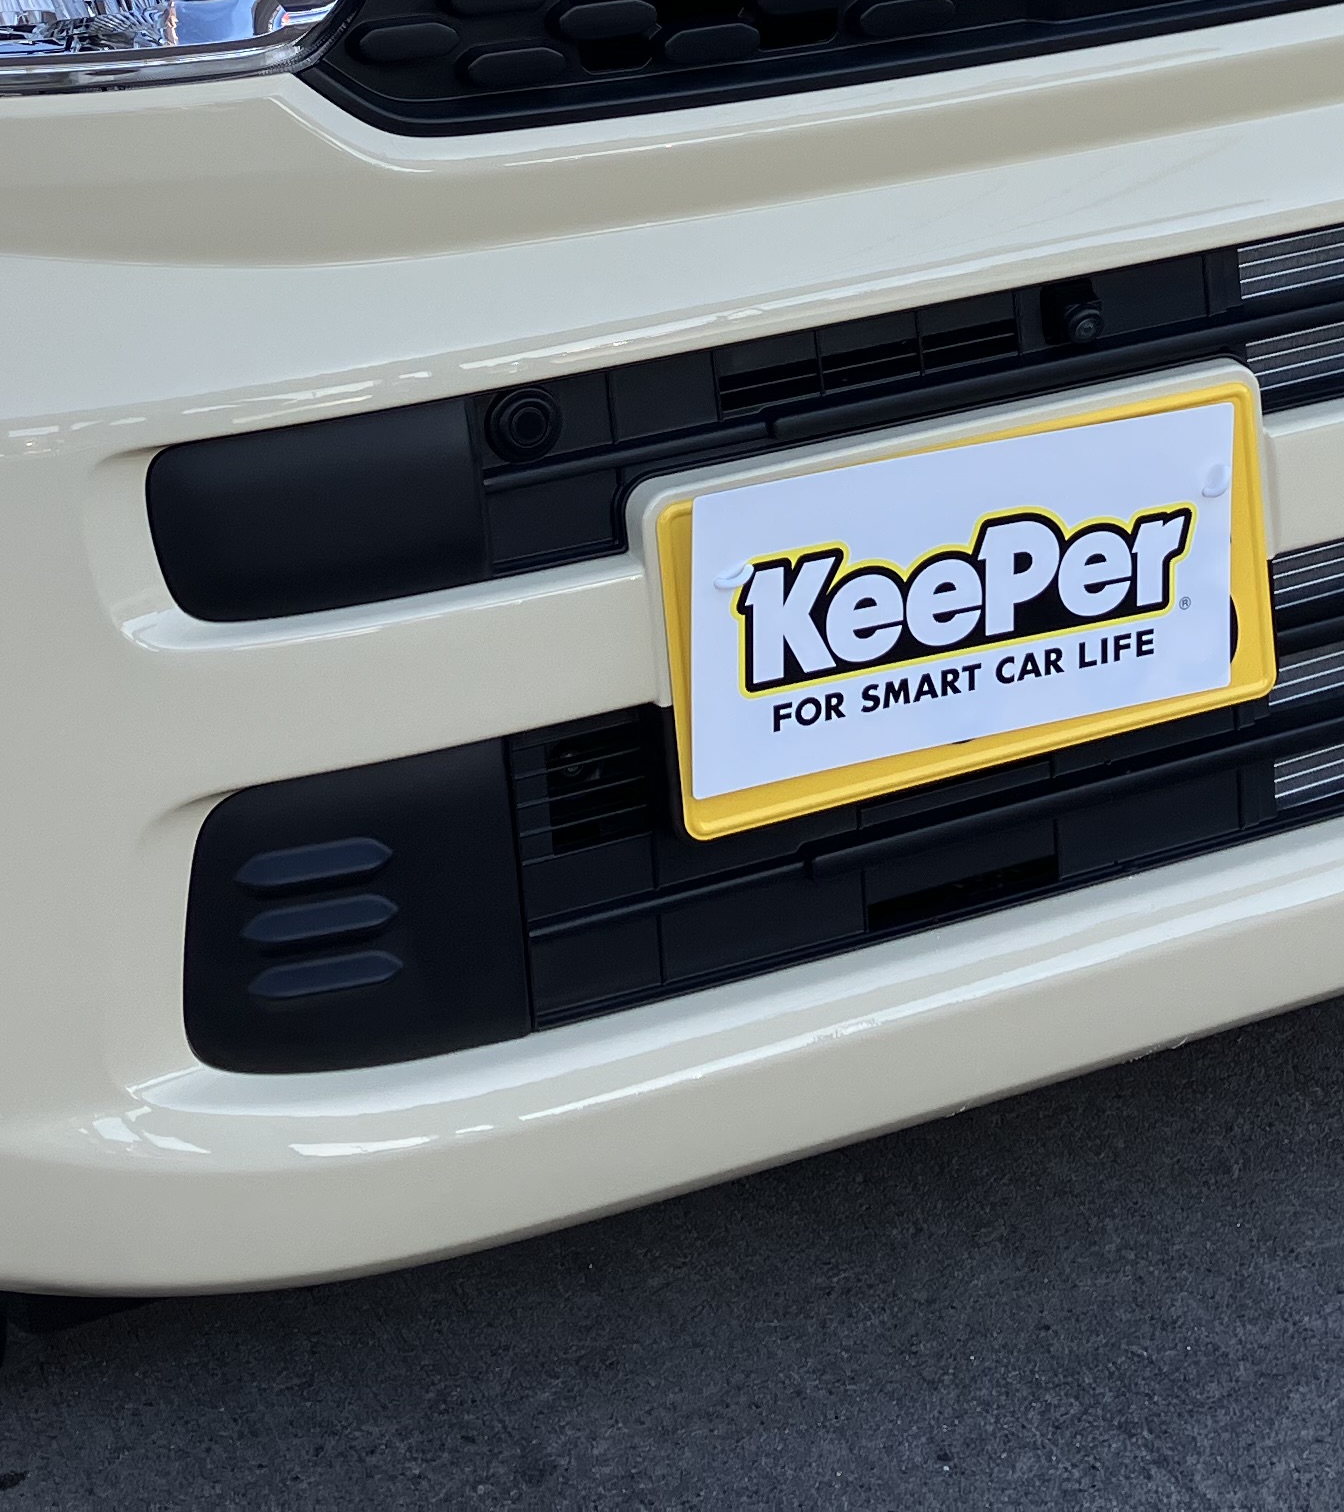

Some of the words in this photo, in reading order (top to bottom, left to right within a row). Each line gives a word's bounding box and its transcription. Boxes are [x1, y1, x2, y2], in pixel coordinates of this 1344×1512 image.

[740, 506, 1193, 693] KeePer
[772, 691, 846, 733] FOR
[860, 662, 983, 713] SMART
[995, 647, 1064, 686] CAR
[1078, 628, 1155, 670] LIFE
